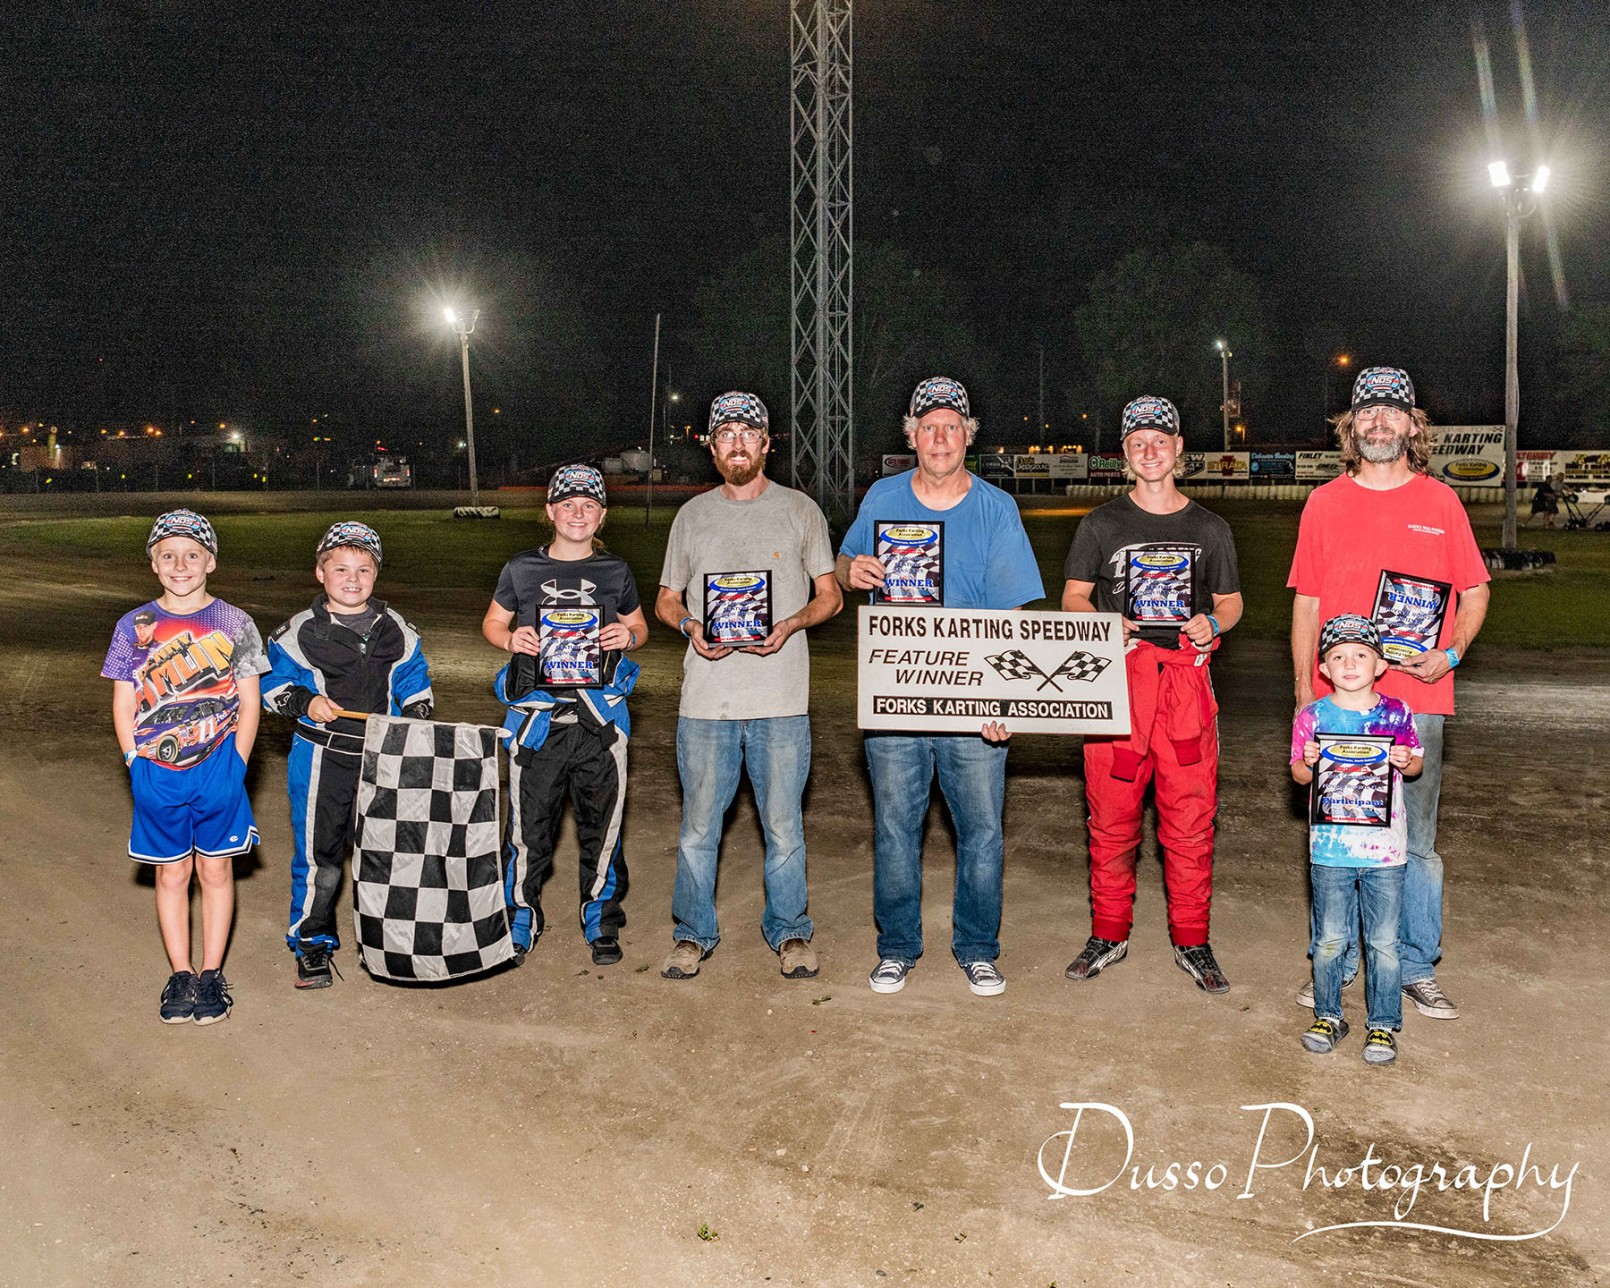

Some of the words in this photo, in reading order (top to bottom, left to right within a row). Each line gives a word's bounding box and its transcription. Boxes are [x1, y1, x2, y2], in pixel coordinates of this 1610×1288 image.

[1444, 432, 1503, 444] KARTING
[1430, 444, 1485, 455] EEDWAY
[1089, 456, 1122, 471] O'Reilly
[1136, 600, 1184, 608] WINNER
[1389, 592, 1438, 610] WINNER
[713, 620, 761, 629] WINNER
[869, 615, 927, 637] FORKS
[934, 617, 1013, 640] KARTING
[1020, 619, 1111, 642] SPEEDWAY
[868, 649, 970, 666] FEATURE
[896, 669, 984, 686] WINNER
[876, 699, 927, 714] FORKS
[933, 700, 1000, 716] KARTING
[1008, 702, 1108, 718] ASSOCIATION
[199, 717, 215, 744] 11
[1322, 797, 1384, 806] Participant
